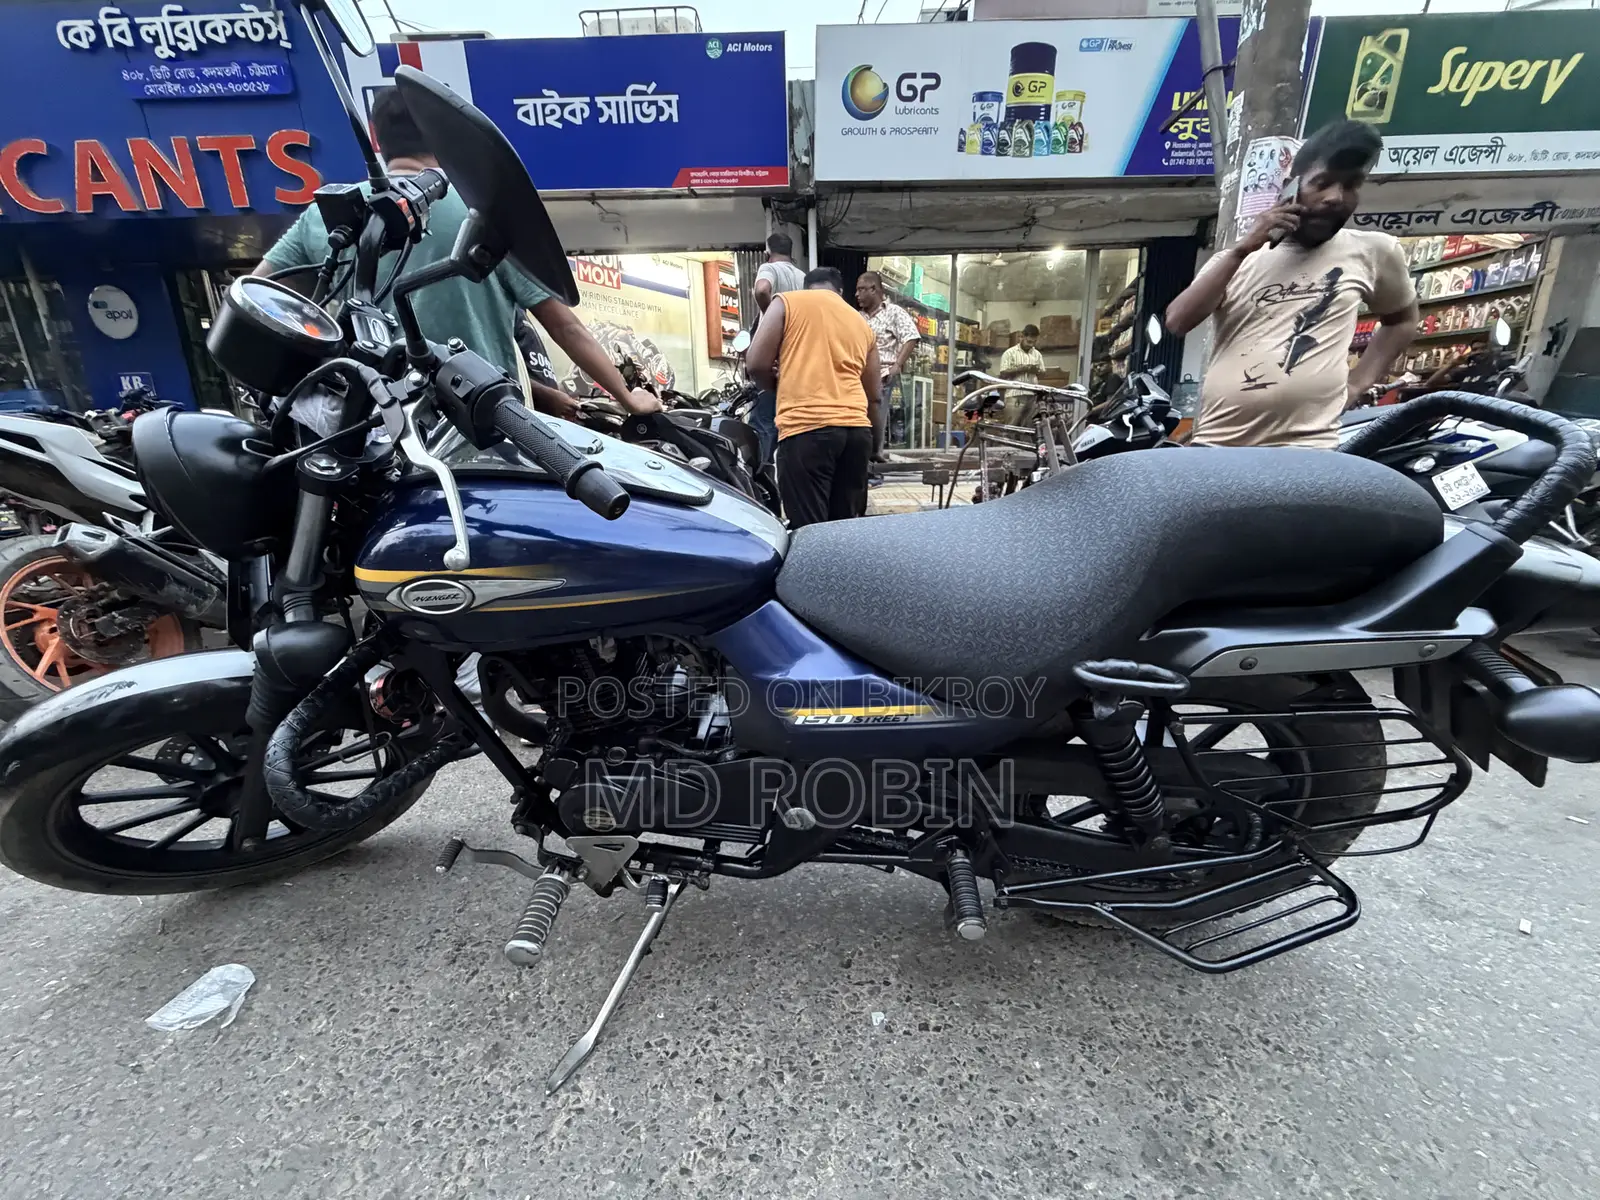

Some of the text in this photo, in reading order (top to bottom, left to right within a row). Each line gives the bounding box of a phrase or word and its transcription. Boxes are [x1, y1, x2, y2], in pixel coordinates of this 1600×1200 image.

[56, 19, 97, 49] কে
[98, 6, 135, 48] বি
[727, 43, 772, 52] ACI Motors
[895, 72, 942, 103] GP
[1028, 80, 1047, 93] GP
[513, 81, 680, 129] বাইক সার্ভিস
[894, 106, 940, 116] Lubricants
[841, 126, 939, 136] GROWTH & PROSPERITY
[0, 129, 323, 214] CANTS
[578, 262, 620, 289] MOLY
[589, 292, 613, 303] RIDING
[613, 296, 647, 311] STANDARD
[647, 304, 662, 313] WITH
[412, 593, 462, 602] AVENGER
[795, 713, 914, 725] 150 STREET
